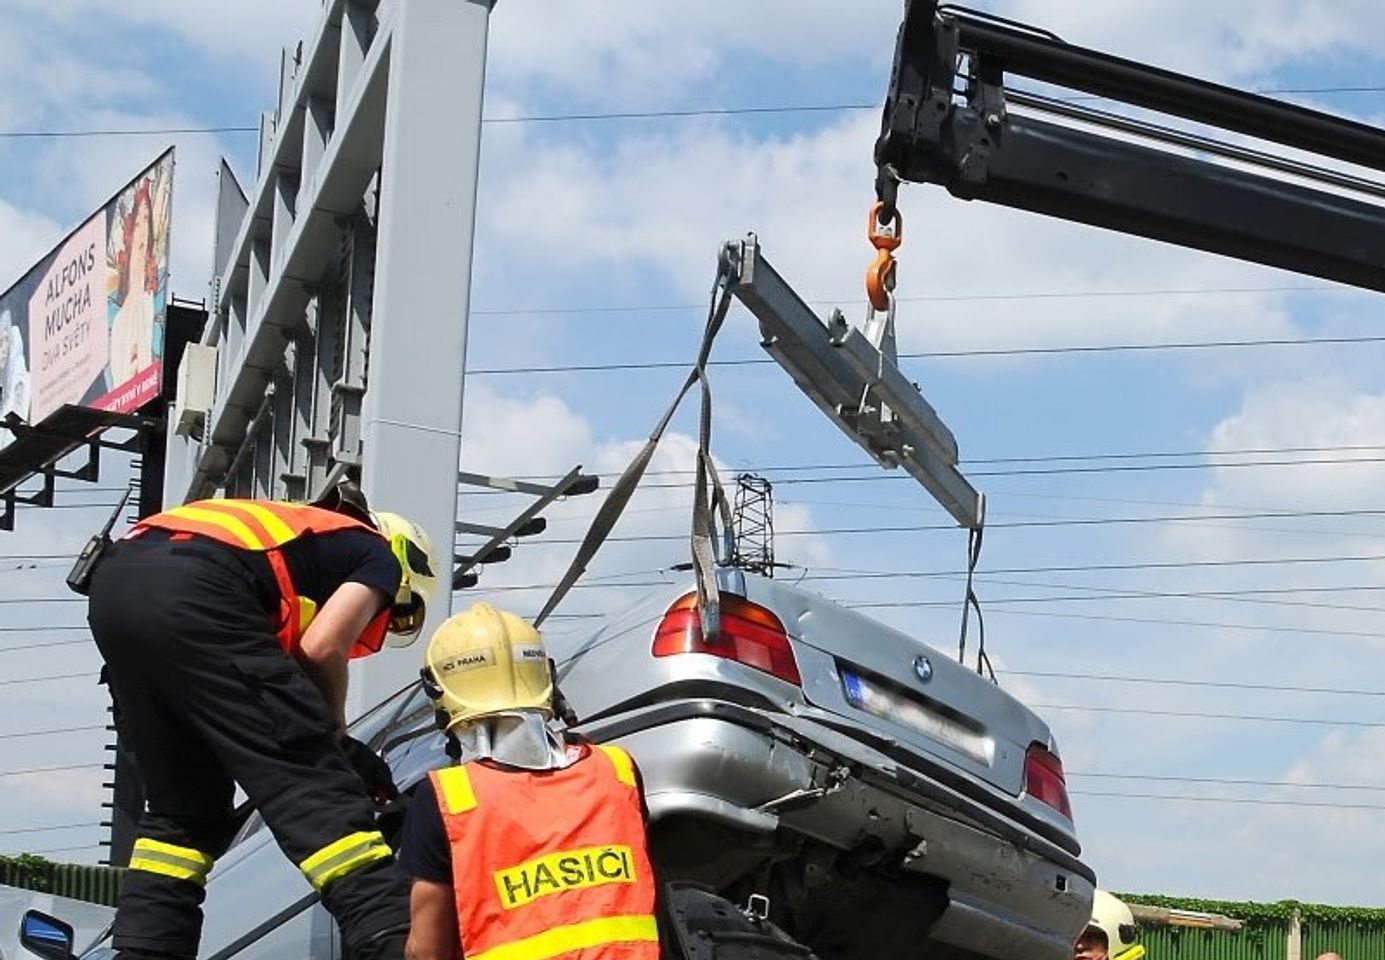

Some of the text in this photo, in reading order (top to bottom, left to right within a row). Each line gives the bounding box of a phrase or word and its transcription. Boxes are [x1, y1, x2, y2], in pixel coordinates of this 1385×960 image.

[45, 243, 95, 306] ALFONS
[44, 282, 92, 341] MUCHA
[457, 654, 486, 666] PRAHA
[503, 848, 630, 903] HASIČI
